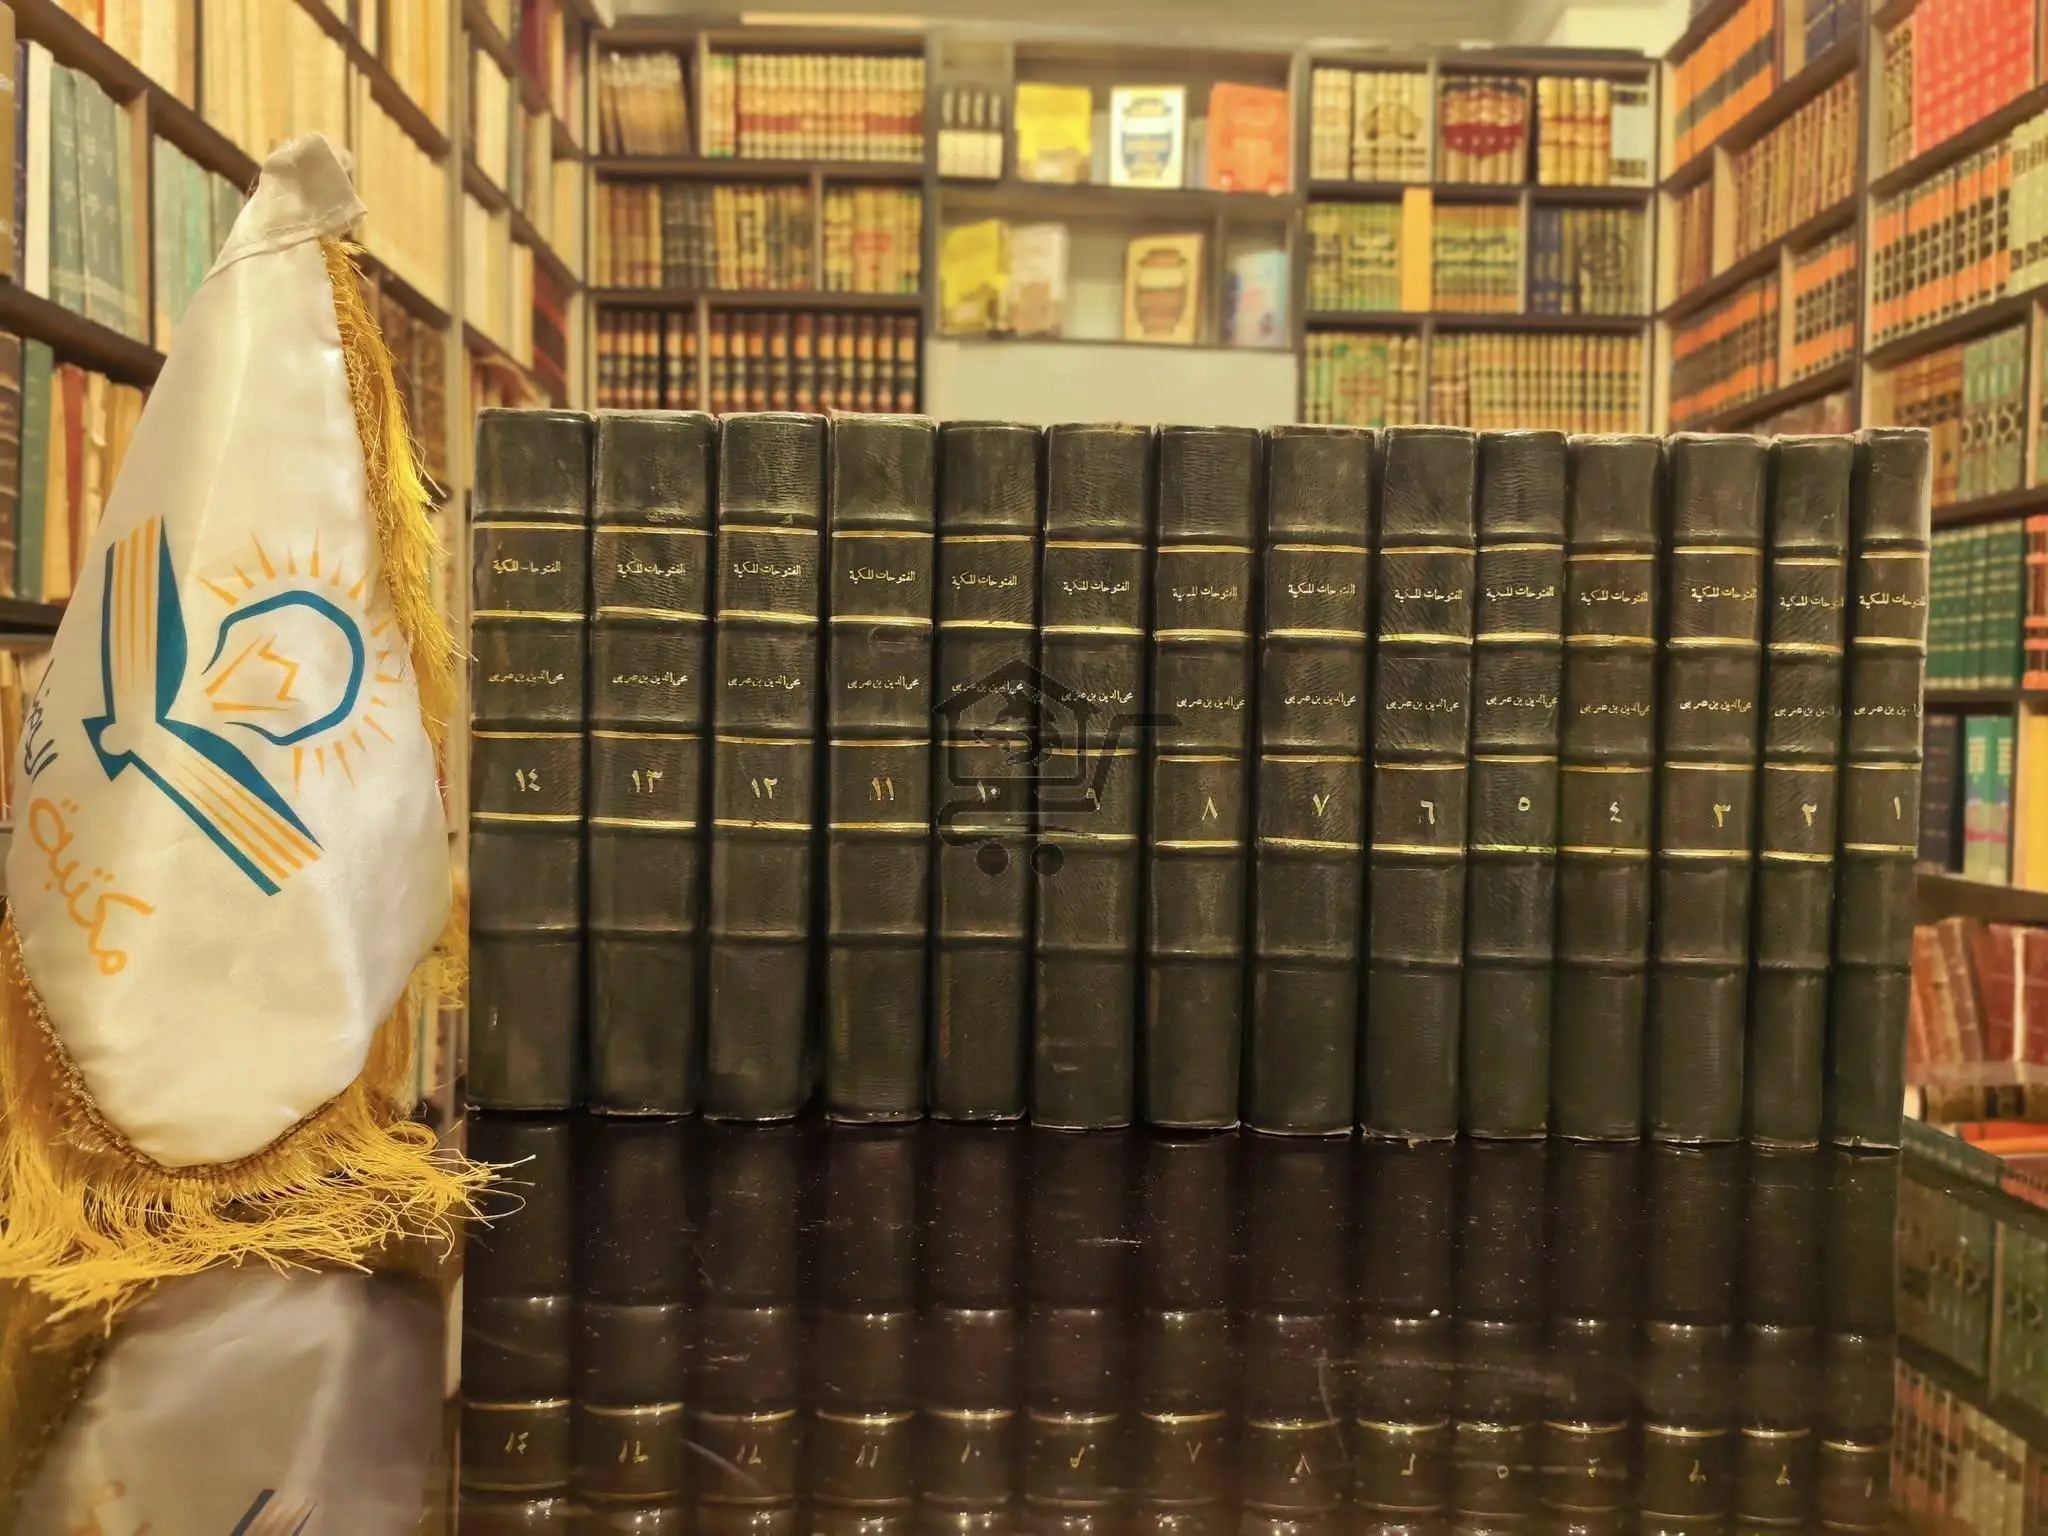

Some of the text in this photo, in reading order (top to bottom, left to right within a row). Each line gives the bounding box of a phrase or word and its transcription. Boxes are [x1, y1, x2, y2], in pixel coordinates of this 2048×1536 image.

[733, 561, 802, 578] الفتوحات المكية
[848, 566, 916, 585] الفتوحات المكية
[951, 572, 1018, 590] الفتوحات المكية
[1062, 579, 1131, 596] الفتوحات المكية
[1288, 581, 1315, 599] المكية
[1690, 585, 1720, 603] المكية
[1859, 592, 1890, 610] المكية
[515, 767, 542, 793] ١٤
[871, 775, 896, 802] ١١
[1201, 796, 1219, 821] ٨
[1312, 793, 1331, 817] ٧
[1420, 799, 1436, 825] ٦
[1517, 796, 1531, 812] ٥
[1609, 801, 1623, 823] ٤
[1893, 796, 1901, 821] ١
[29, 797, 156, 975] مكتبة
